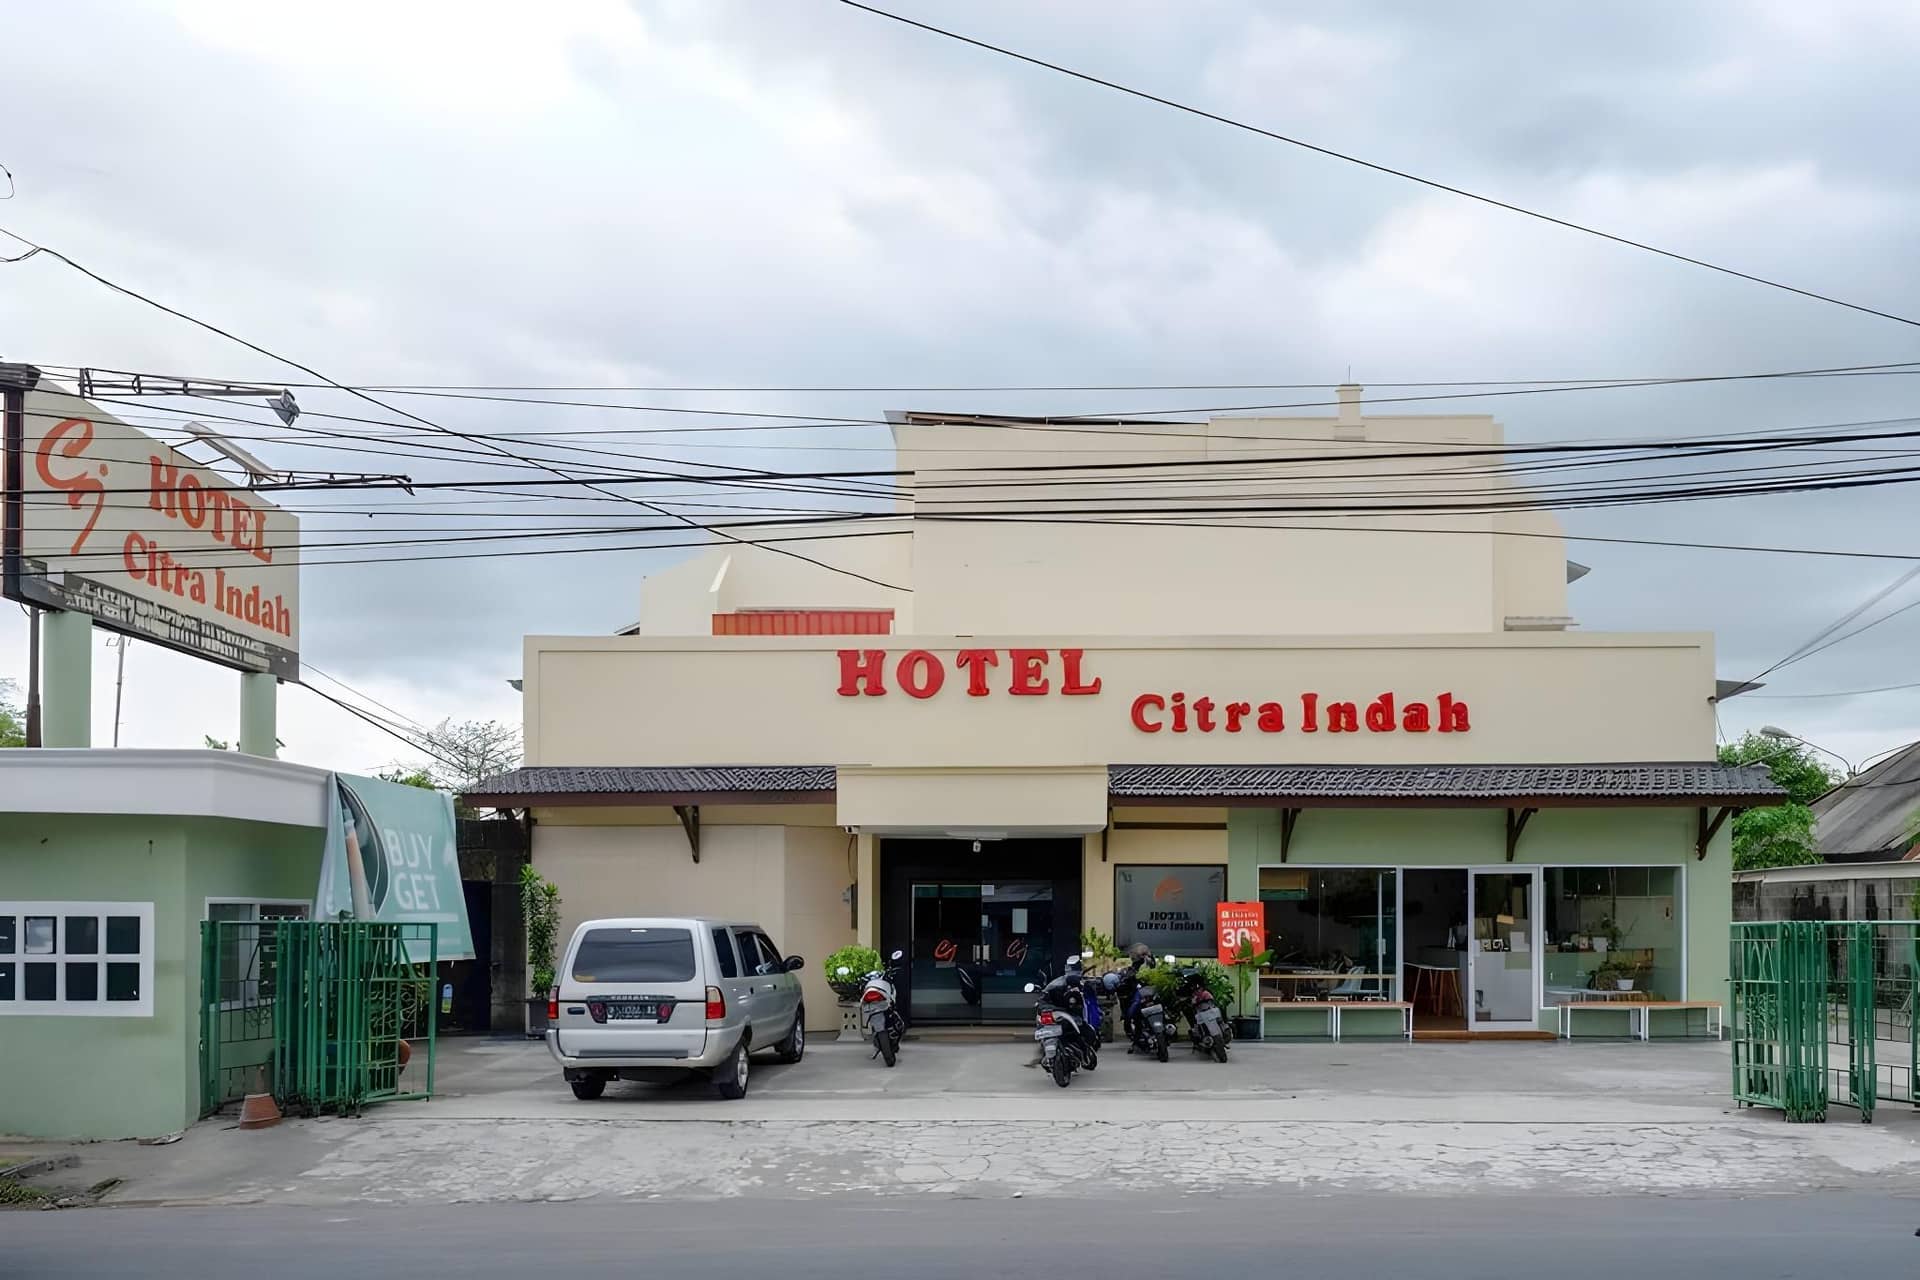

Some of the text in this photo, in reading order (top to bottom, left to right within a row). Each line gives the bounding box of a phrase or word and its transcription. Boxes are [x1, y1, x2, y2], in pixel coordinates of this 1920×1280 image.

[149, 455, 272, 563] HOTEL
[123, 531, 206, 605] Citra
[214, 567, 291, 637] Indah
[836, 650, 1102, 698] HOTEL
[1131, 692, 1472, 734] Citra Indah
[383, 828, 433, 870] BUY
[394, 872, 440, 911] GET
